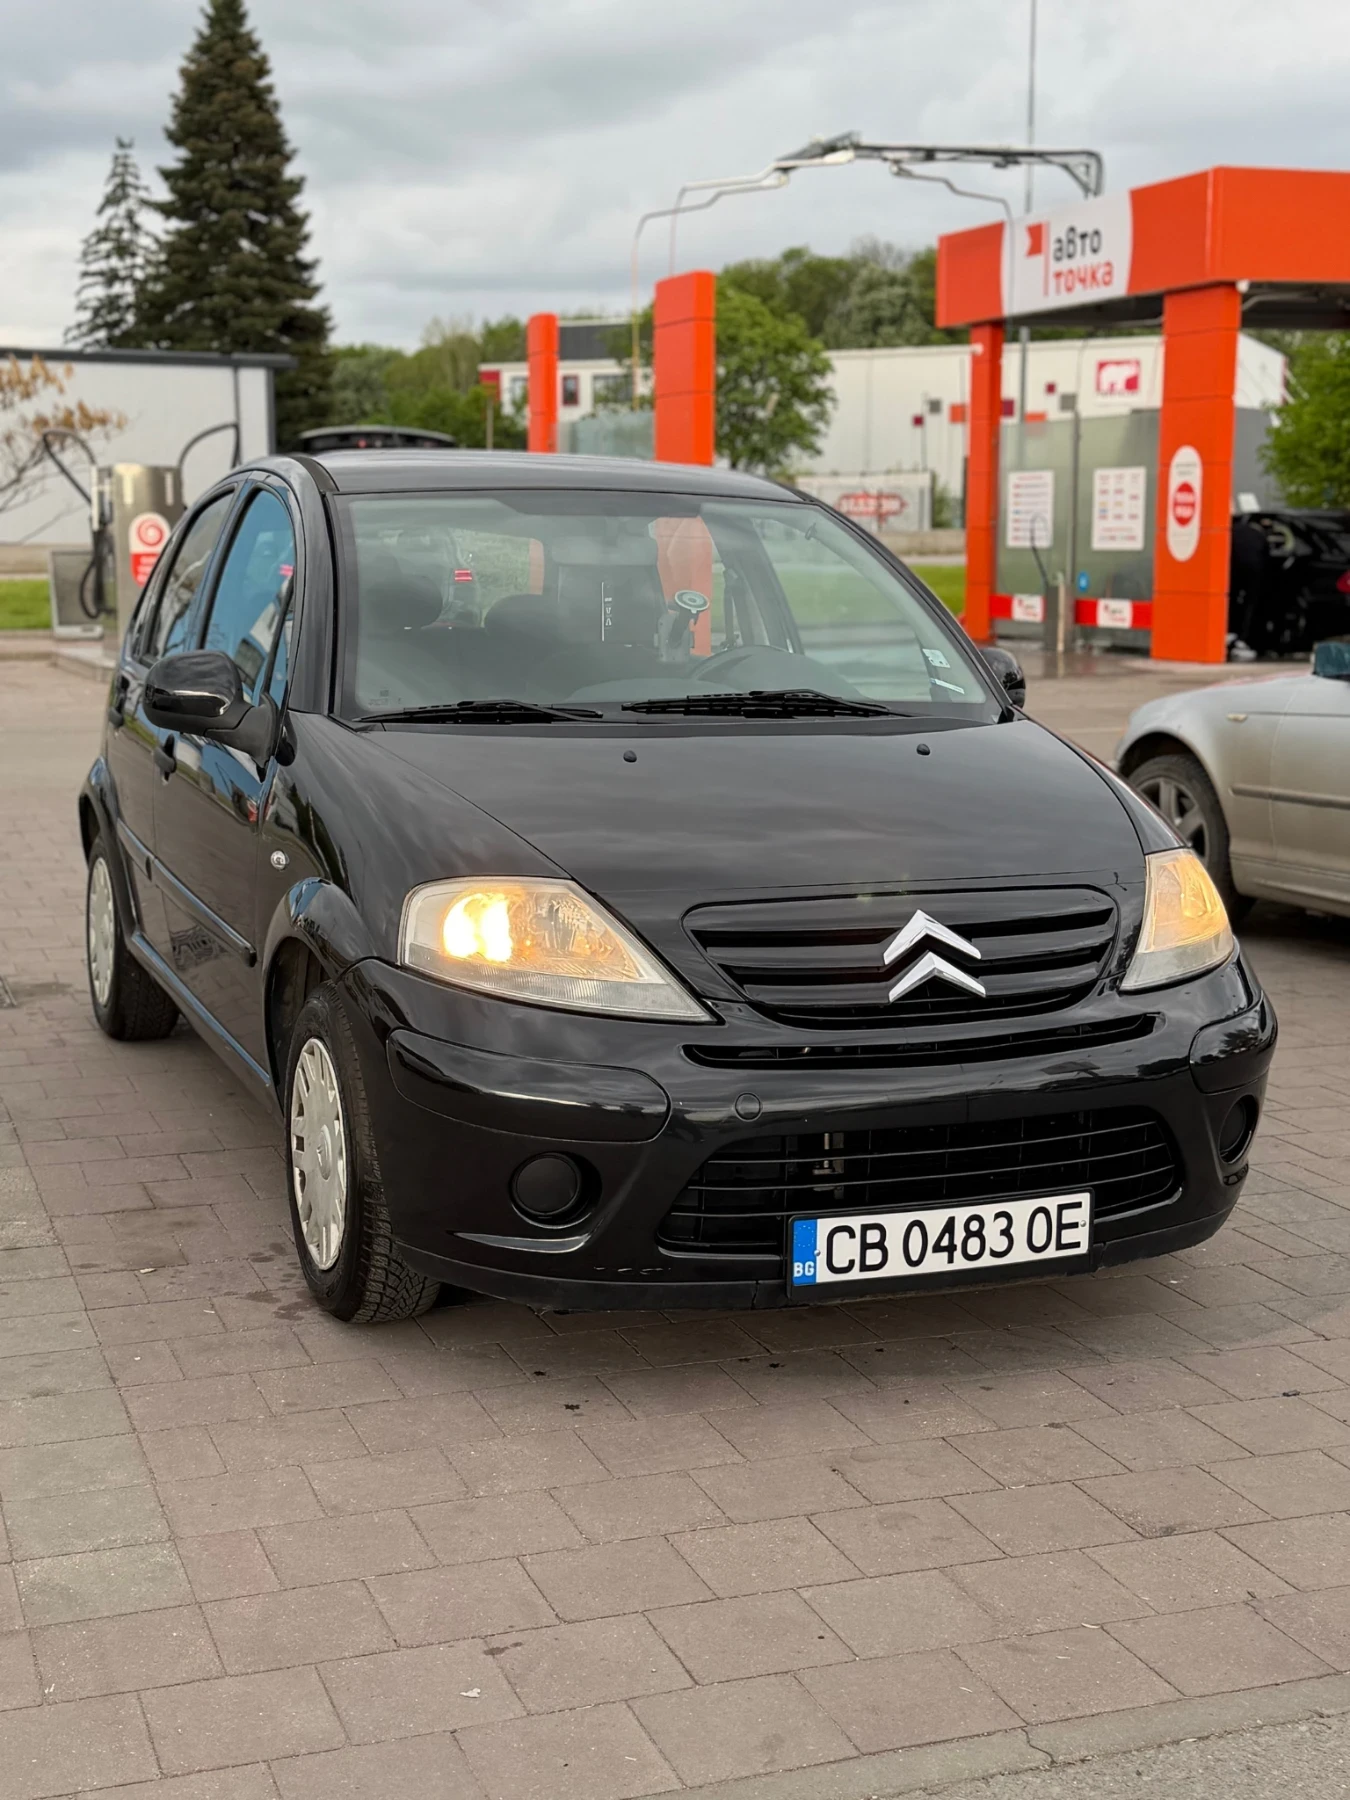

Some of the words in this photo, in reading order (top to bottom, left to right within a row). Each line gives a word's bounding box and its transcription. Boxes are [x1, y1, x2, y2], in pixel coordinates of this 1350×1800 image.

[1053, 226, 1102, 262] авто
[1053, 261, 1113, 295] точка
[826, 1222, 889, 1274] CB
[903, 1210, 1014, 1267] 0483
[793, 1260, 814, 1278] BG
